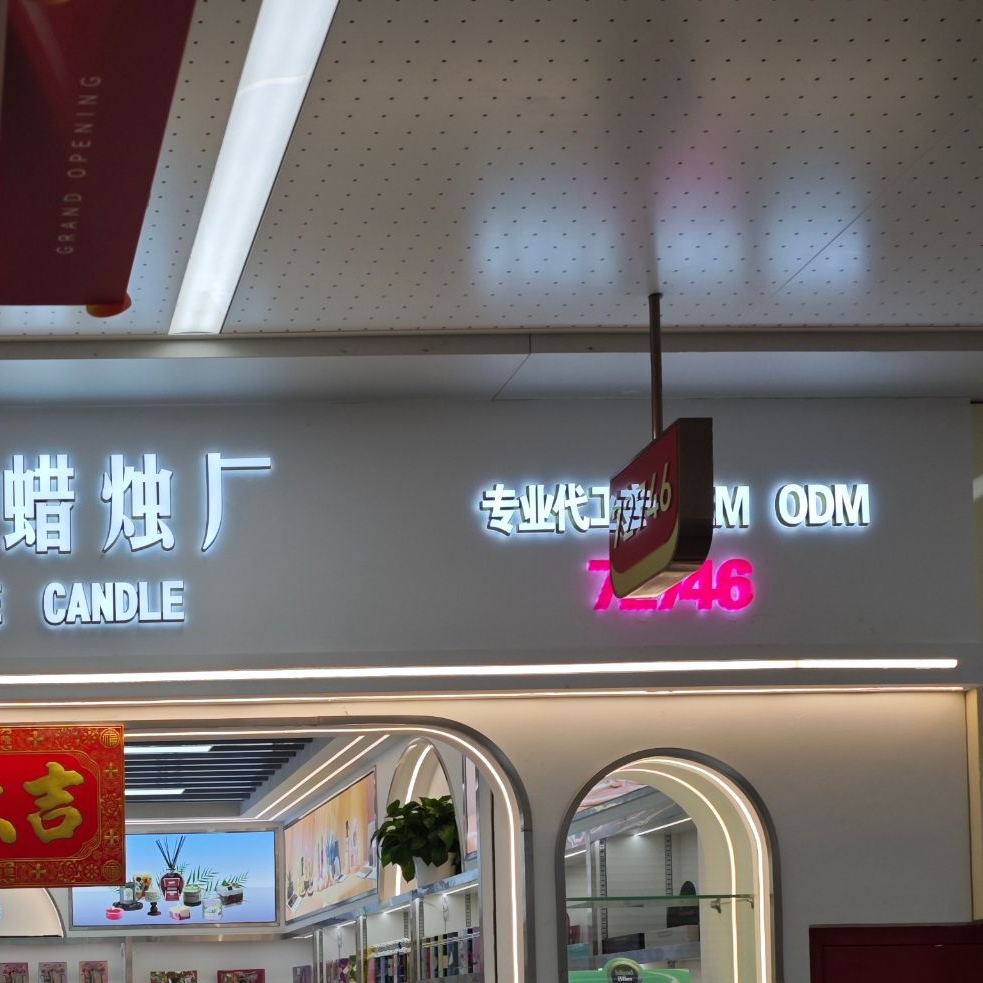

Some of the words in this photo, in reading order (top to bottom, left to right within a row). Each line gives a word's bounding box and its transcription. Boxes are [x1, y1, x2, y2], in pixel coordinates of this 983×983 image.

[68, 75, 102, 179] OPENING
[57, 192, 82, 255] GRAND
[776, 483, 870, 528] ODM
[43, 580, 185, 626] CANDLE
[586, 559, 754, 611] 746
